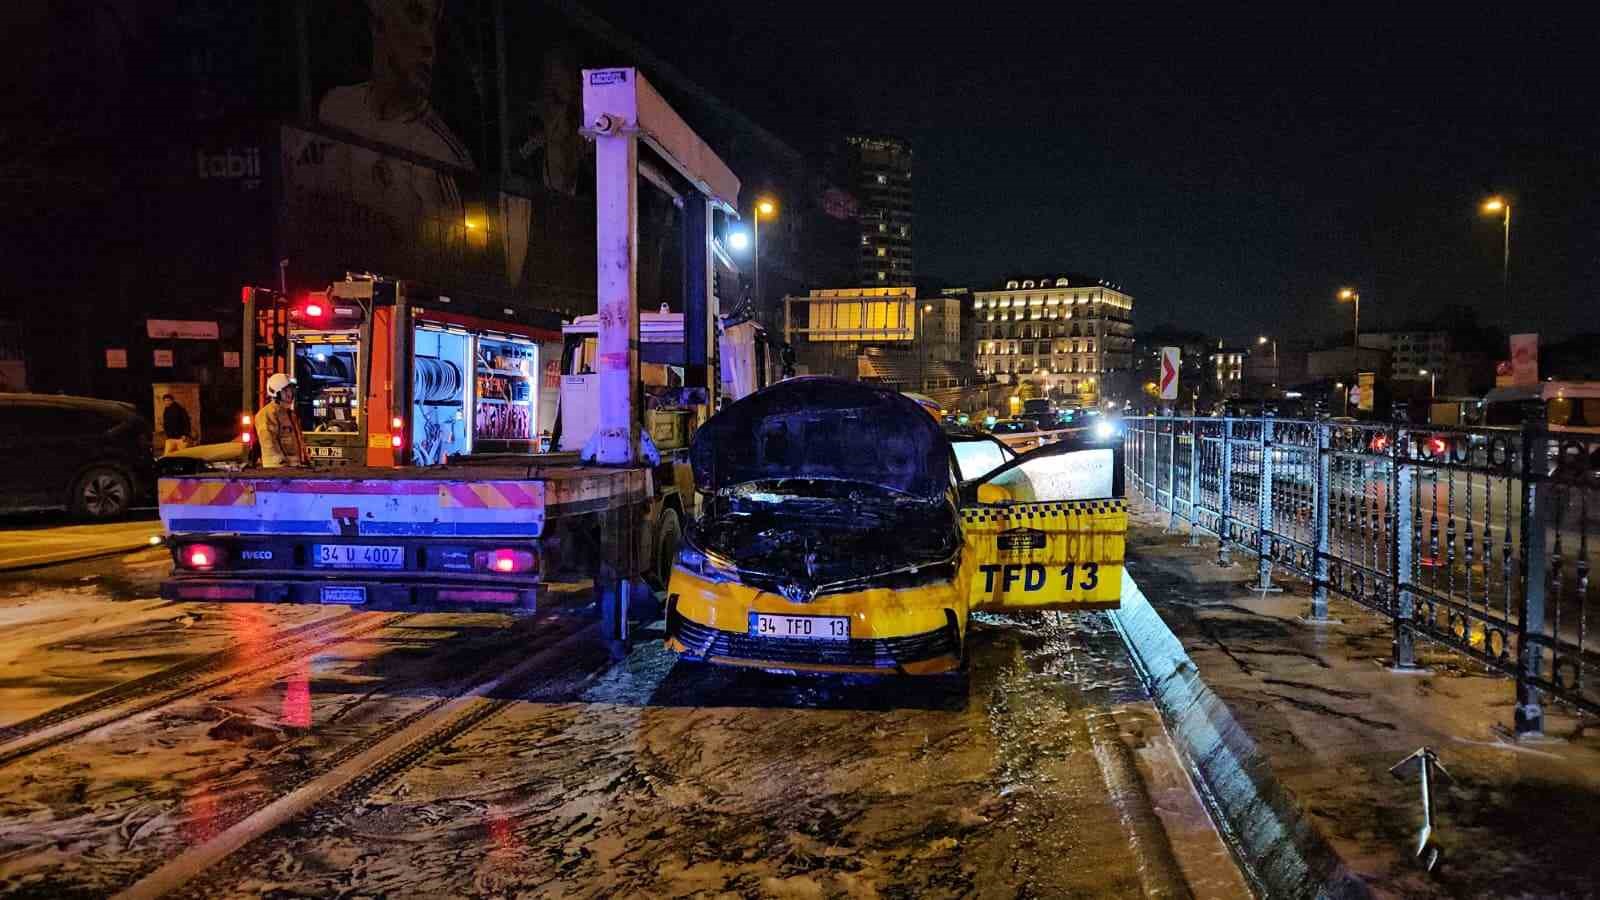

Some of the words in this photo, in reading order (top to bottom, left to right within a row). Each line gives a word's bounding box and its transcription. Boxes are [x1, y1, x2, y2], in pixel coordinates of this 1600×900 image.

[196, 147, 262, 178] tabii
[241, 551, 273, 560] IVECO
[323, 547, 338, 561] 34
[346, 548, 355, 561] U
[364, 548, 399, 562] 4007
[979, 562, 1047, 592] TFD
[1061, 561, 1098, 591] 13
[760, 617, 776, 632] 34
[786, 618, 812, 634] TFD
[829, 620, 844, 636] 13
